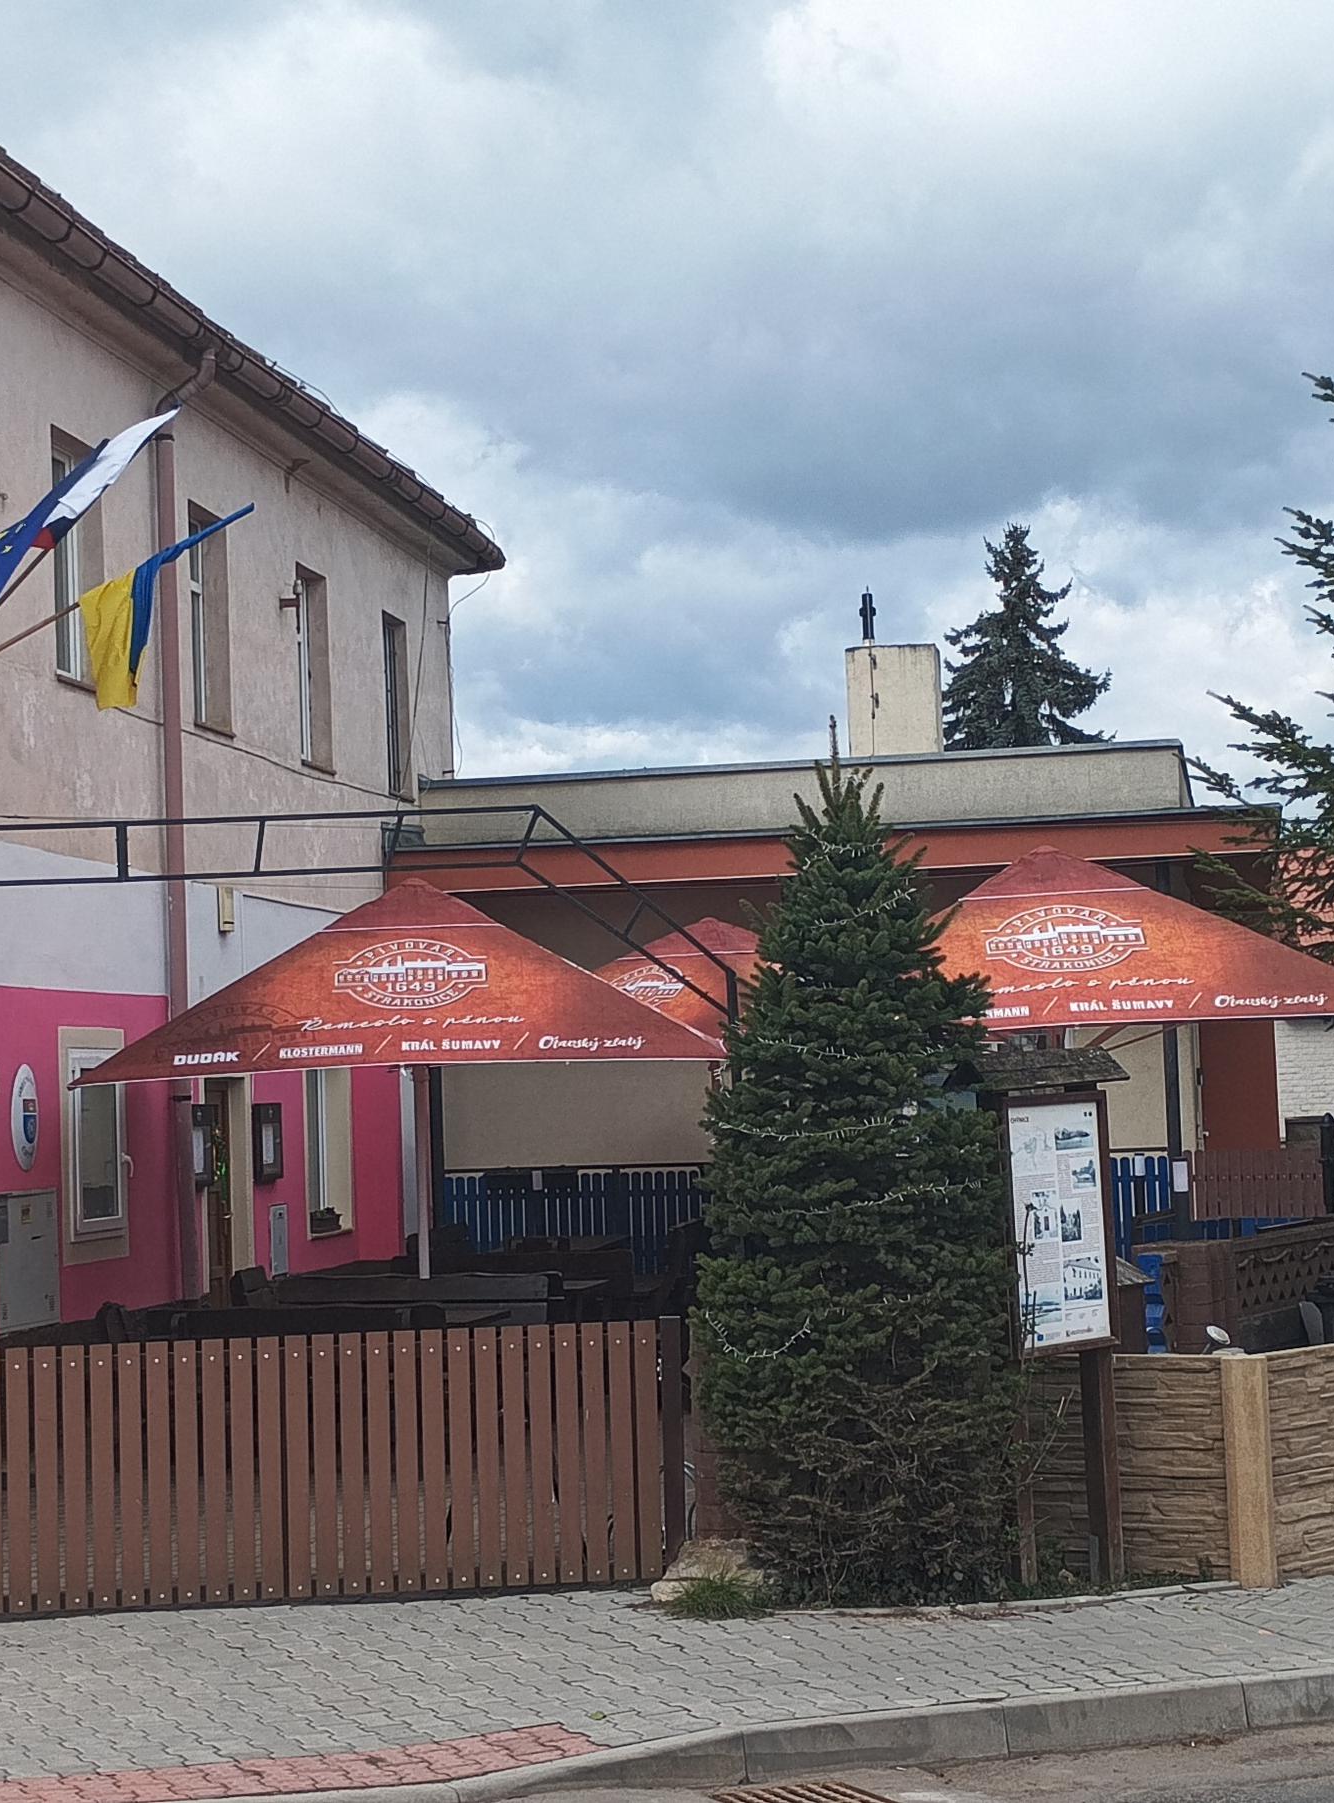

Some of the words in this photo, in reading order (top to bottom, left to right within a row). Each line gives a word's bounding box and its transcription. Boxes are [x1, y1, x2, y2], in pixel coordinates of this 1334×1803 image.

[1012, 907, 1107, 928] PIVOVAR
[364, 941, 456, 960] PIVOVAR
[1040, 944, 1094, 957] 1649
[1019, 952, 1119, 969] STRAKONICE
[385, 981, 436, 993] 1649
[966, 977, 1079, 995] meslo
[363, 989, 459, 1006] STRAKONICE
[1069, 1000, 1108, 1012] KRÁL
[1112, 998, 1174, 1010] ŠUMAVY
[279, 1043, 363, 1059] KLOSTERMANN
[401, 1038, 437, 1051] KRÁL
[441, 1038, 501, 1050] ŠUMAVY
